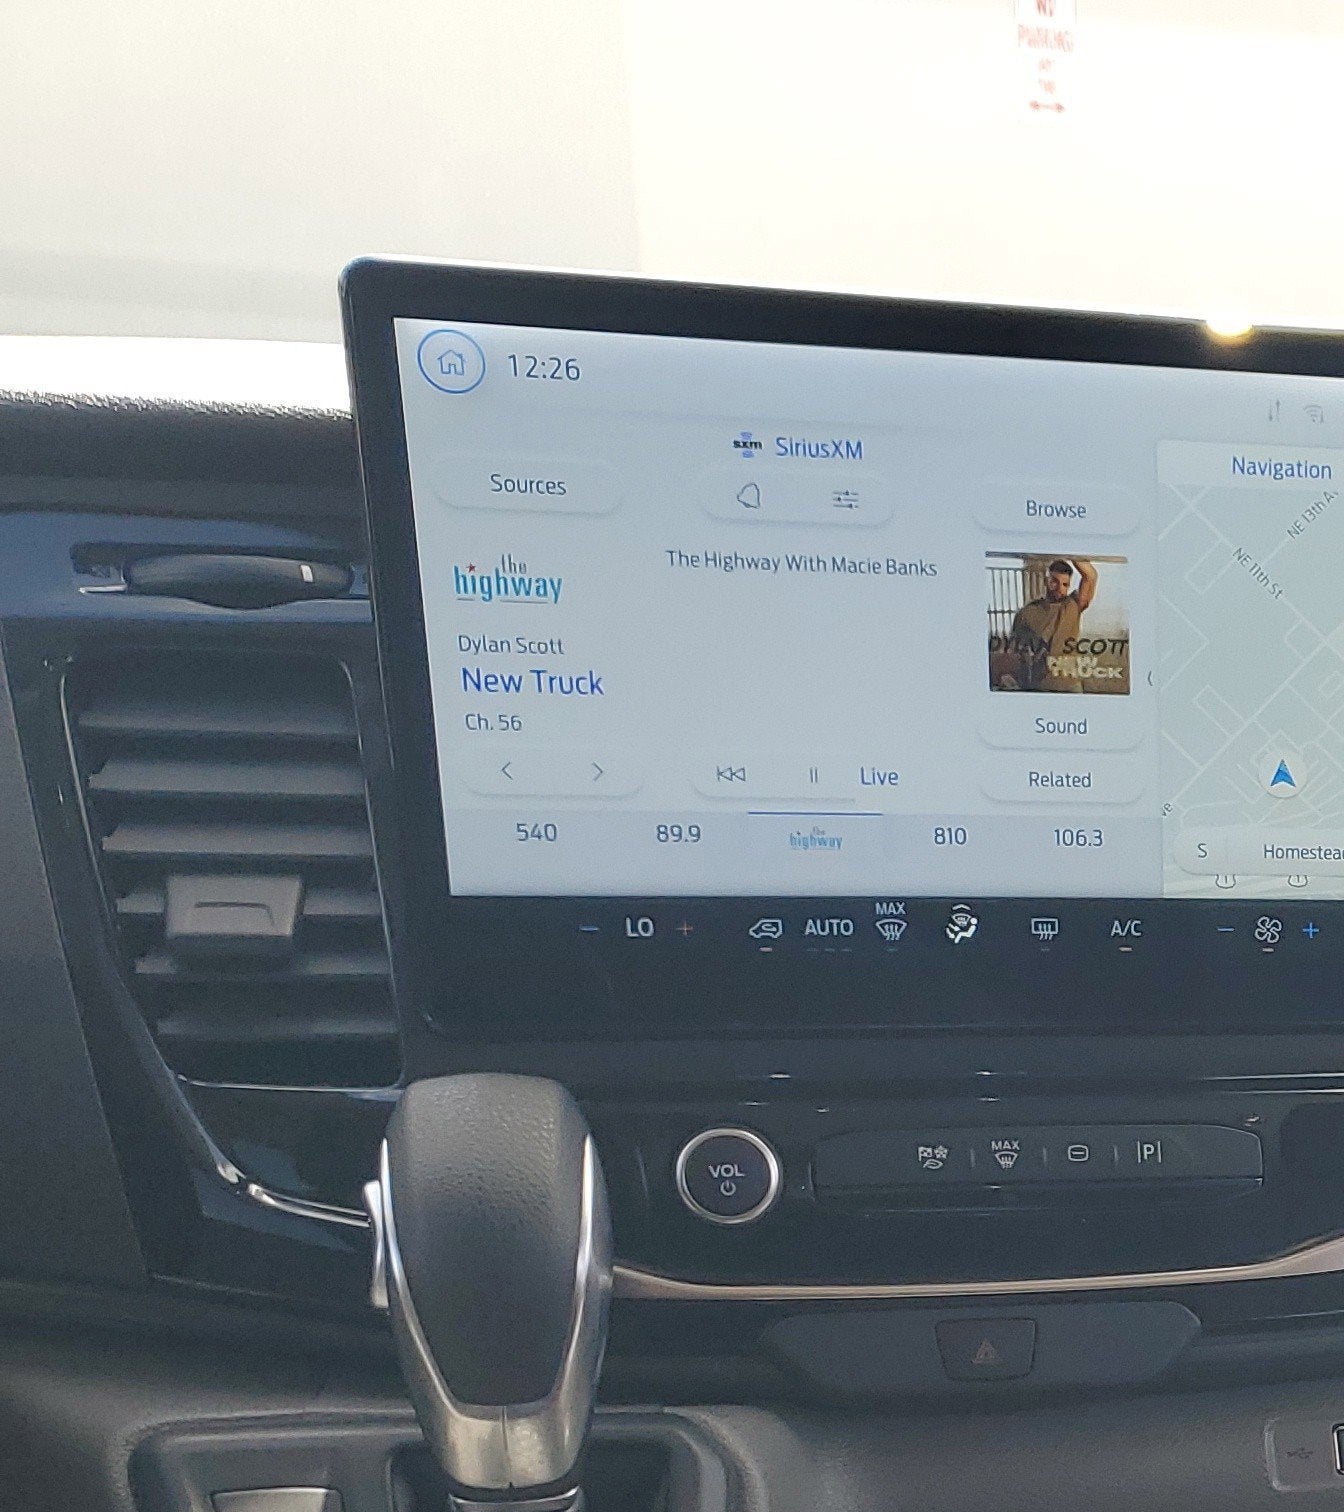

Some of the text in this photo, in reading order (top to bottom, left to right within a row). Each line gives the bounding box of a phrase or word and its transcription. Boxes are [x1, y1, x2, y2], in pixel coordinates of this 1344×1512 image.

[507, 353, 581, 382] 12:26
[775, 436, 864, 461] SiriusXM
[1231, 456, 1333, 483] Navigation
[489, 472, 567, 497] Sources
[1026, 499, 1087, 520] Browse
[1287, 520, 1305, 540] NE
[1302, 501, 1327, 523] 13th
[500, 553, 528, 575] the
[665, 548, 938, 578] The Highway With Macie Banks
[1232, 547, 1284, 600] NE 11th St
[453, 565, 563, 603] highway
[457, 634, 566, 658] Dylan Scott
[1063, 636, 1129, 655] SCOTT
[461, 667, 606, 697] New Truck
[464, 712, 523, 733] Ch. 56
[1034, 717, 1089, 737] Sound
[859, 765, 900, 787] Live
[1028, 769, 1093, 790] Related
[515, 822, 559, 844] 540
[656, 823, 702, 845] 89.9
[934, 826, 968, 847] 810
[1053, 827, 1105, 849] 106.3
[1197, 842, 1209, 860] S
[875, 901, 907, 916] MAX
[625, 917, 655, 938] LO
[804, 918, 855, 937] AUTO
[1110, 918, 1143, 939] A/C
[990, 1139, 1021, 1152] MAX
[708, 1164, 746, 1179] VOL
